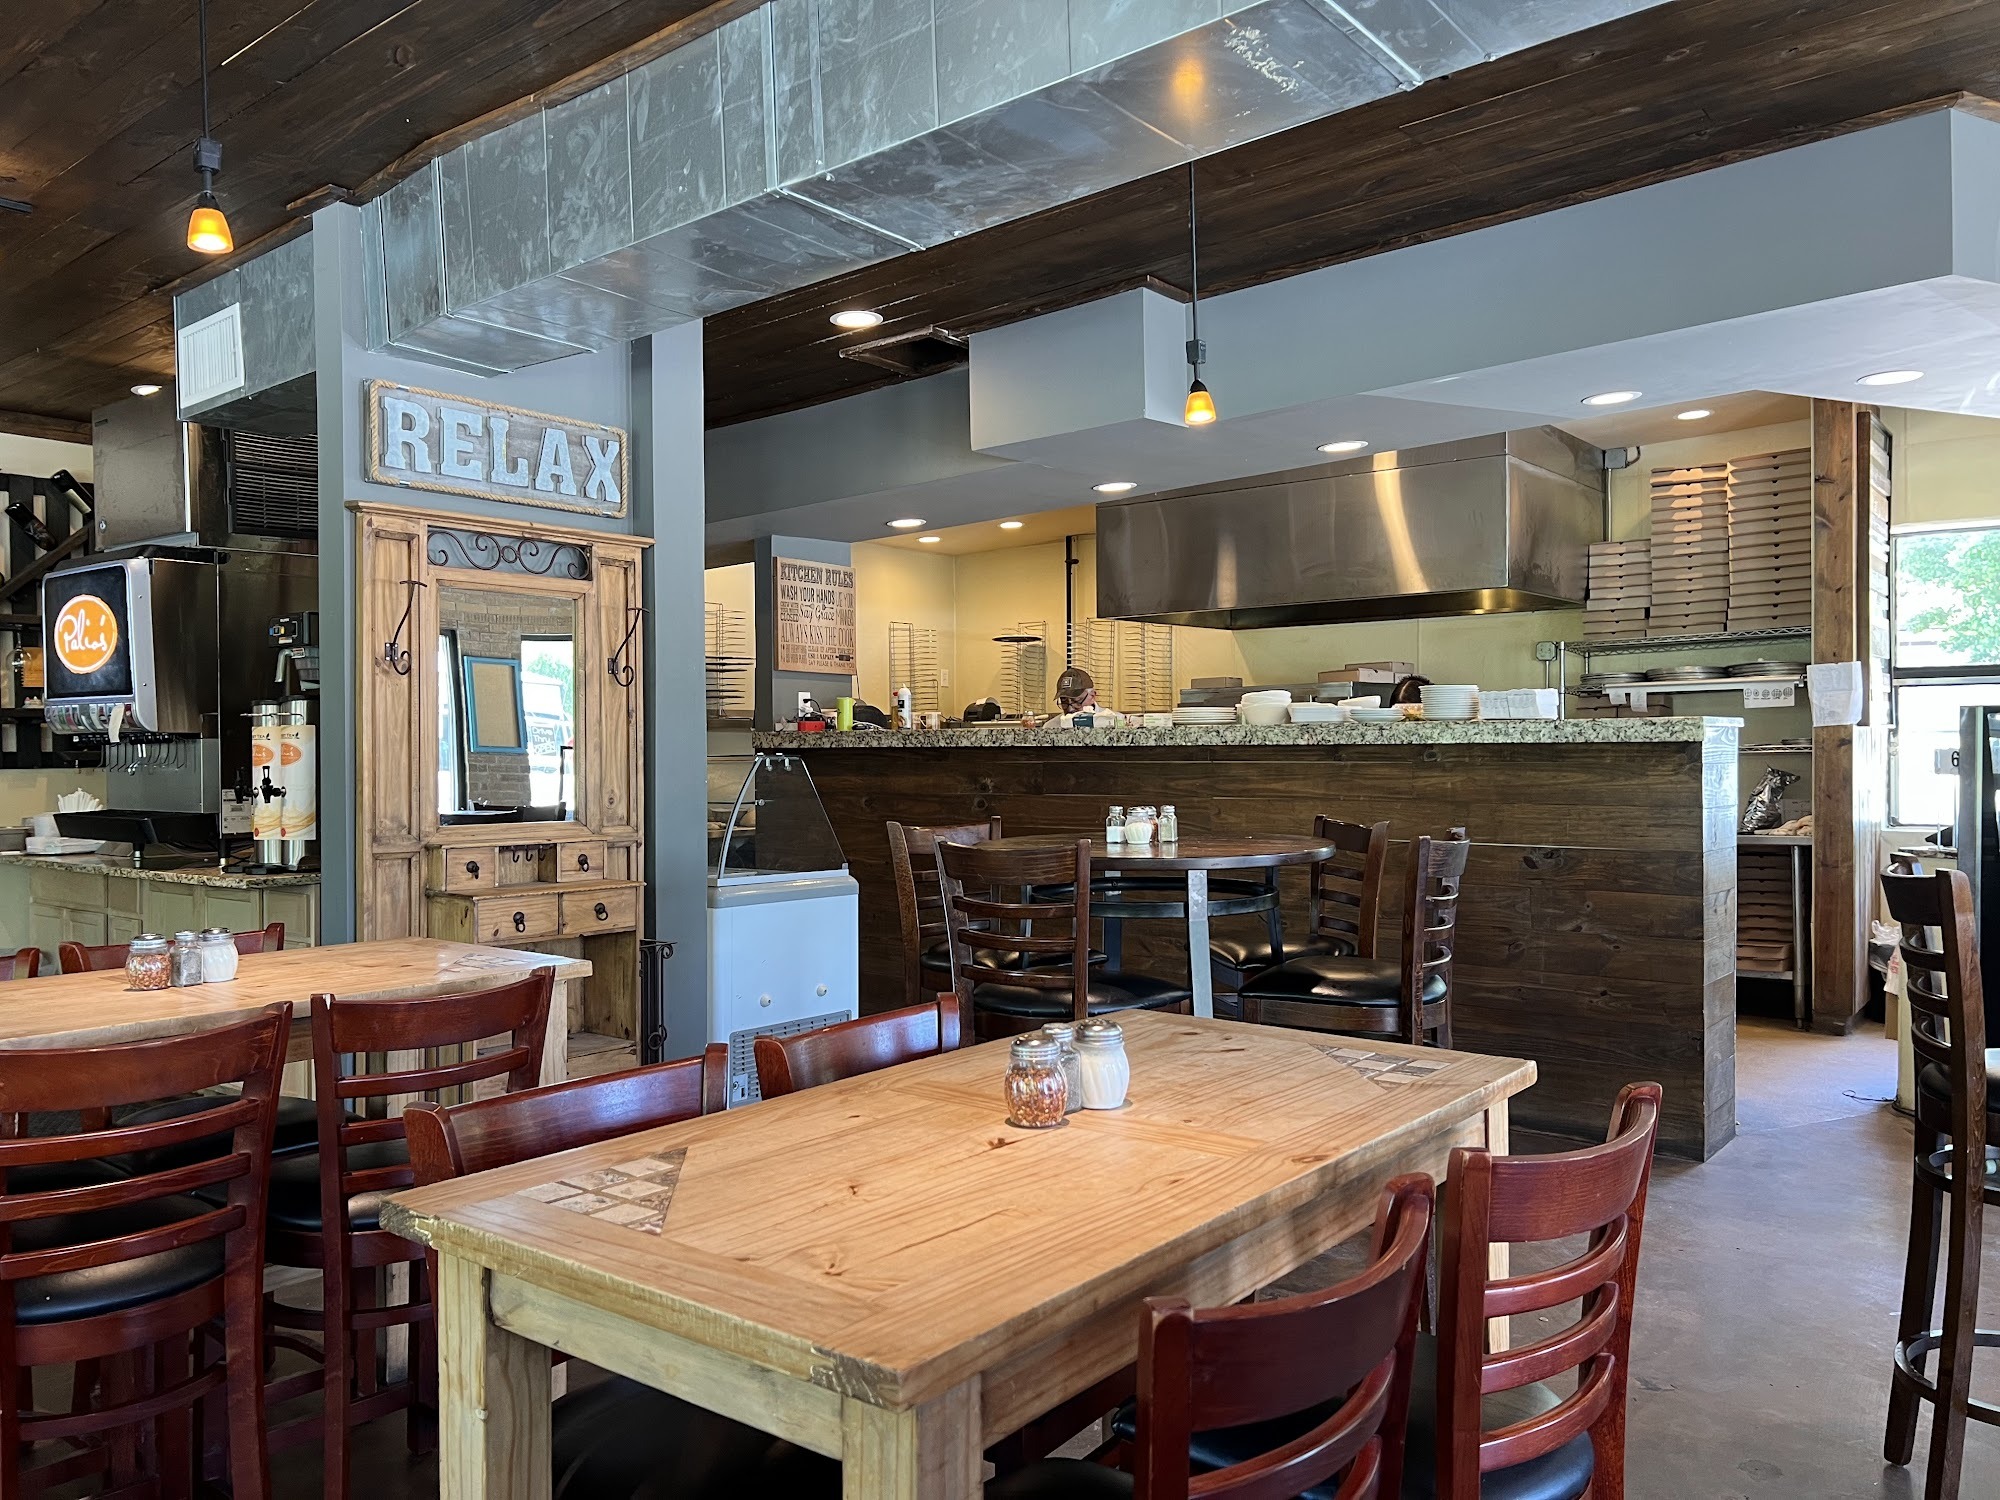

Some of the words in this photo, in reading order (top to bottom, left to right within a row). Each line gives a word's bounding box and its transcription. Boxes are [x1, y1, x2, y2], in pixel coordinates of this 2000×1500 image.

[382, 396, 621, 503] RELAX
[780, 562, 823, 585] KITCHEN
[825, 568, 854, 588] RULES
[780, 584, 798, 600] WASH
[800, 586, 815, 602] YOUR
[816, 588, 835, 605] HANDS
[799, 603, 813, 623] Say
[815, 605, 835, 622] Grace
[60, 608, 108, 654] Palio's
[780, 623, 808, 644] ALWAYS
[809, 625, 824, 646] KISS
[825, 627, 837, 647] THE
[838, 628, 854, 648] COOK
